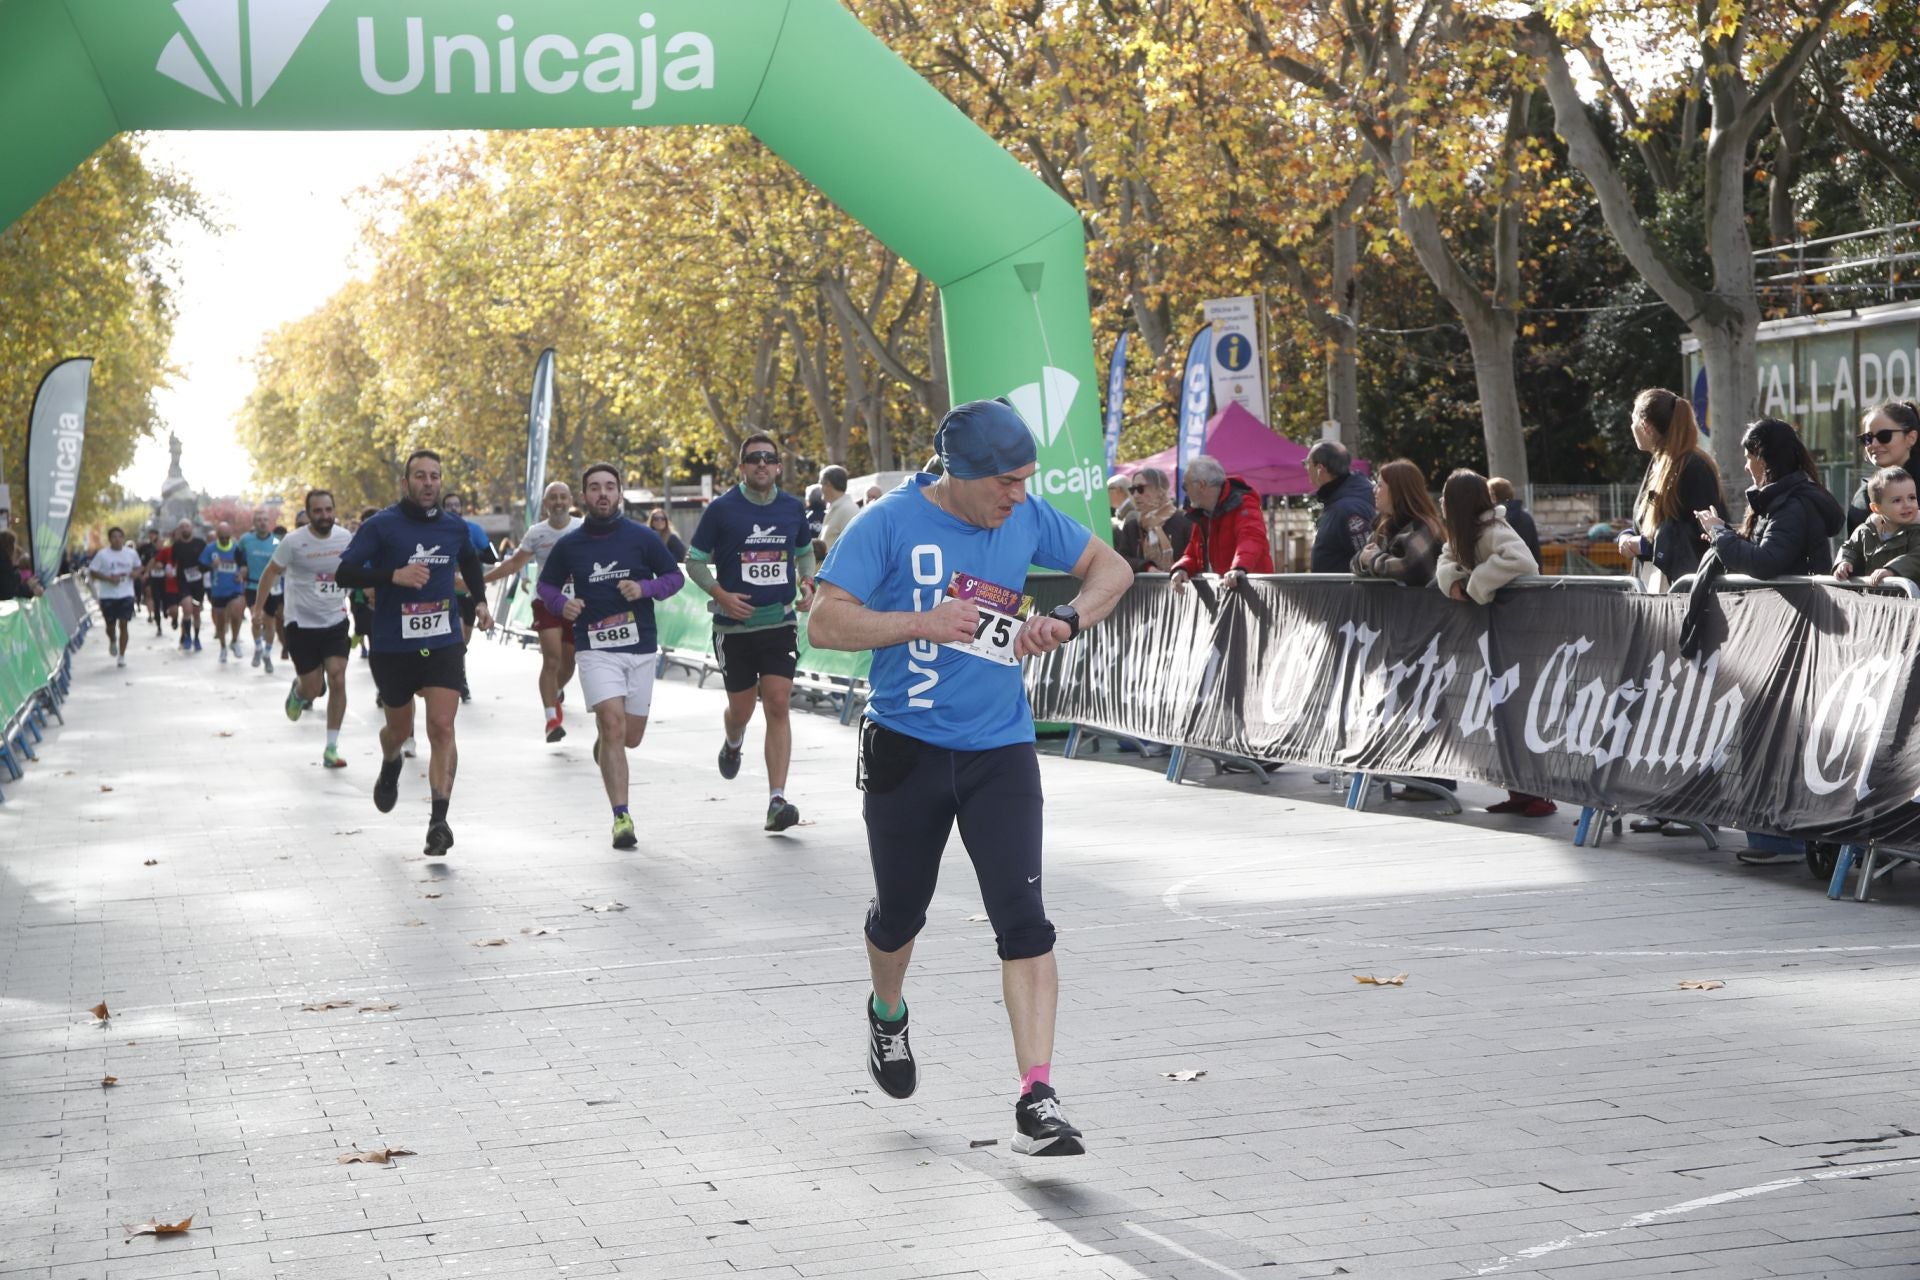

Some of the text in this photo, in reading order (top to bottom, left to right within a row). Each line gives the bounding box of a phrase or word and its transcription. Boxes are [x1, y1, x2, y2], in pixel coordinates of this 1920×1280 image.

[357, 12, 715, 110] Unicaja
[1187, 363, 1208, 463] VECO
[48, 412, 85, 519] Unicaja
[1025, 458, 1104, 501] icaja
[588, 571, 631, 583] MICHELIN
[748, 564, 780, 578] 686
[975, 588, 1008, 605] EMPRESAS
[977, 582, 1002, 595] CARRERA
[409, 614, 442, 631] 687
[596, 627, 631, 642] 688
[974, 611, 1012, 648] 75
[1523, 636, 1744, 776] Castilla
